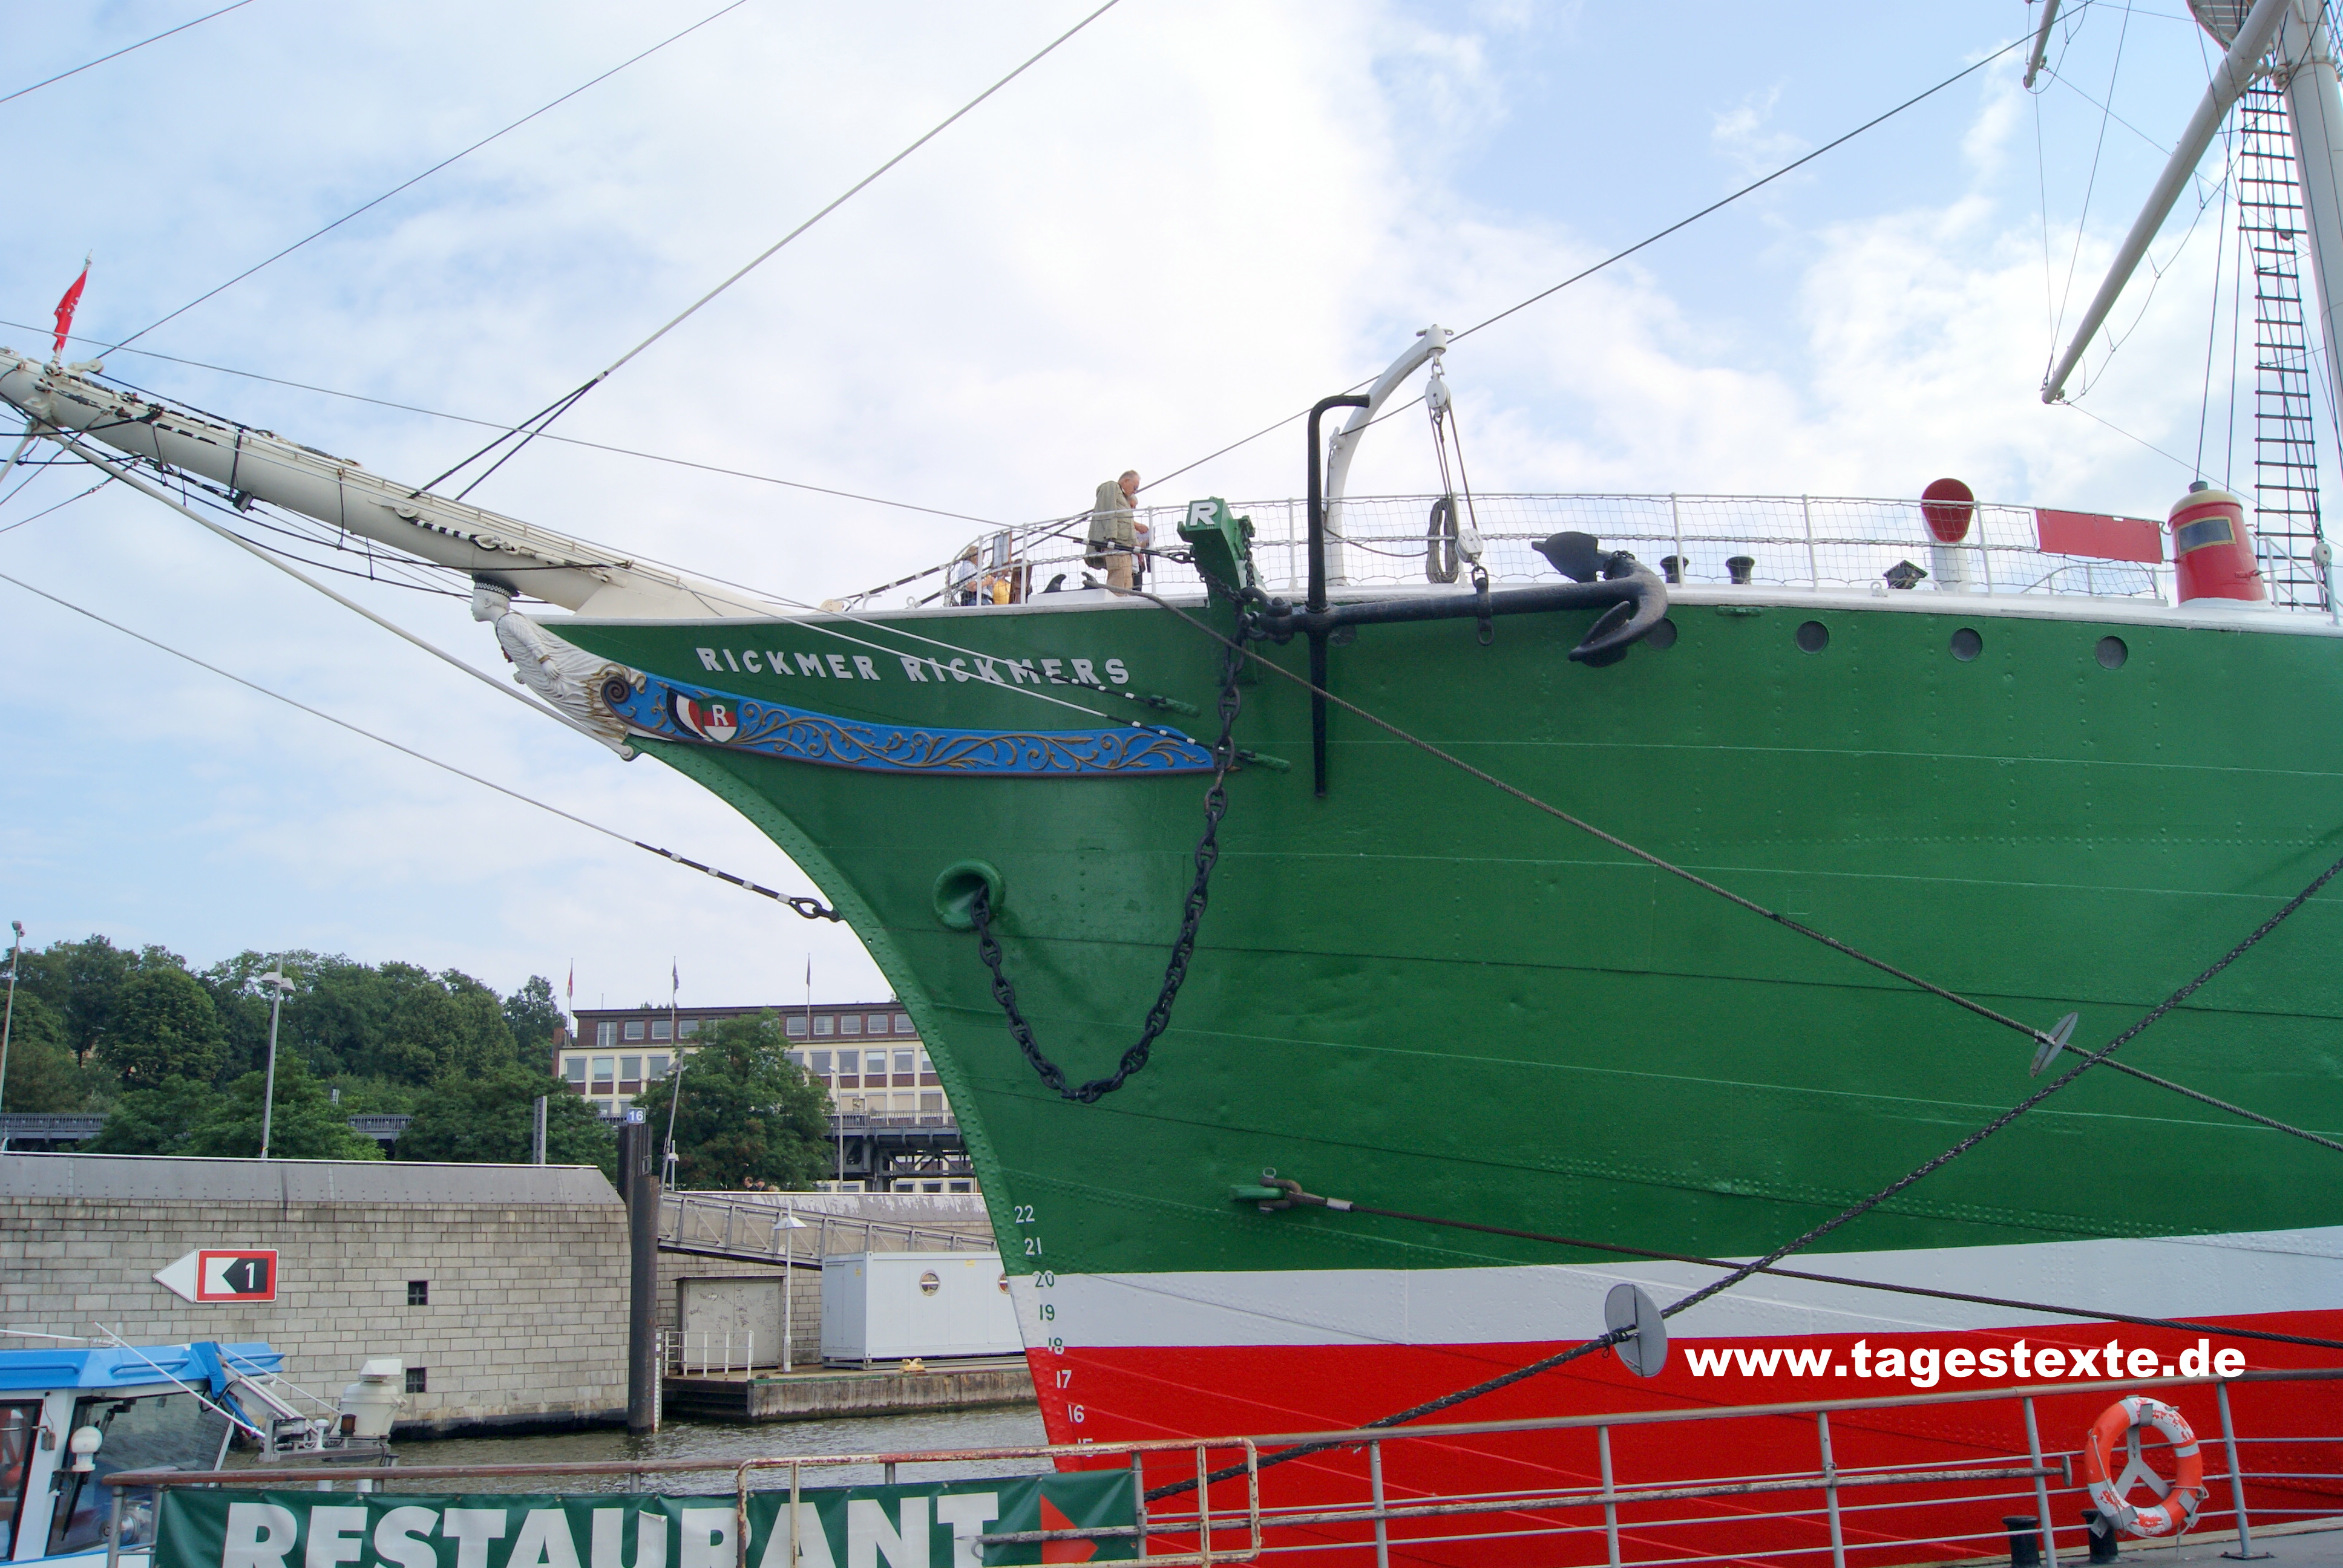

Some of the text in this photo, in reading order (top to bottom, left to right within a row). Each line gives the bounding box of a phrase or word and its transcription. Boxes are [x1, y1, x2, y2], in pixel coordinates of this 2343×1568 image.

[1189, 501, 1218, 526] R
[696, 647, 1130, 684] RICKMER RICKMERS
[712, 704, 729, 727] R
[629, 1110, 644, 1122] 16
[1015, 1204, 1035, 1223] 22
[1024, 1237, 1042, 1255] 21
[245, 1262, 255, 1289] 1
[1033, 1270, 1055, 1287] 20
[1040, 1304, 1055, 1321] 19
[1048, 1337, 1065, 1355] 18
[1056, 1369, 1072, 1388] 17
[1067, 1403, 1085, 1423] 16
[222, 1492, 999, 1568] RESTAURANT
